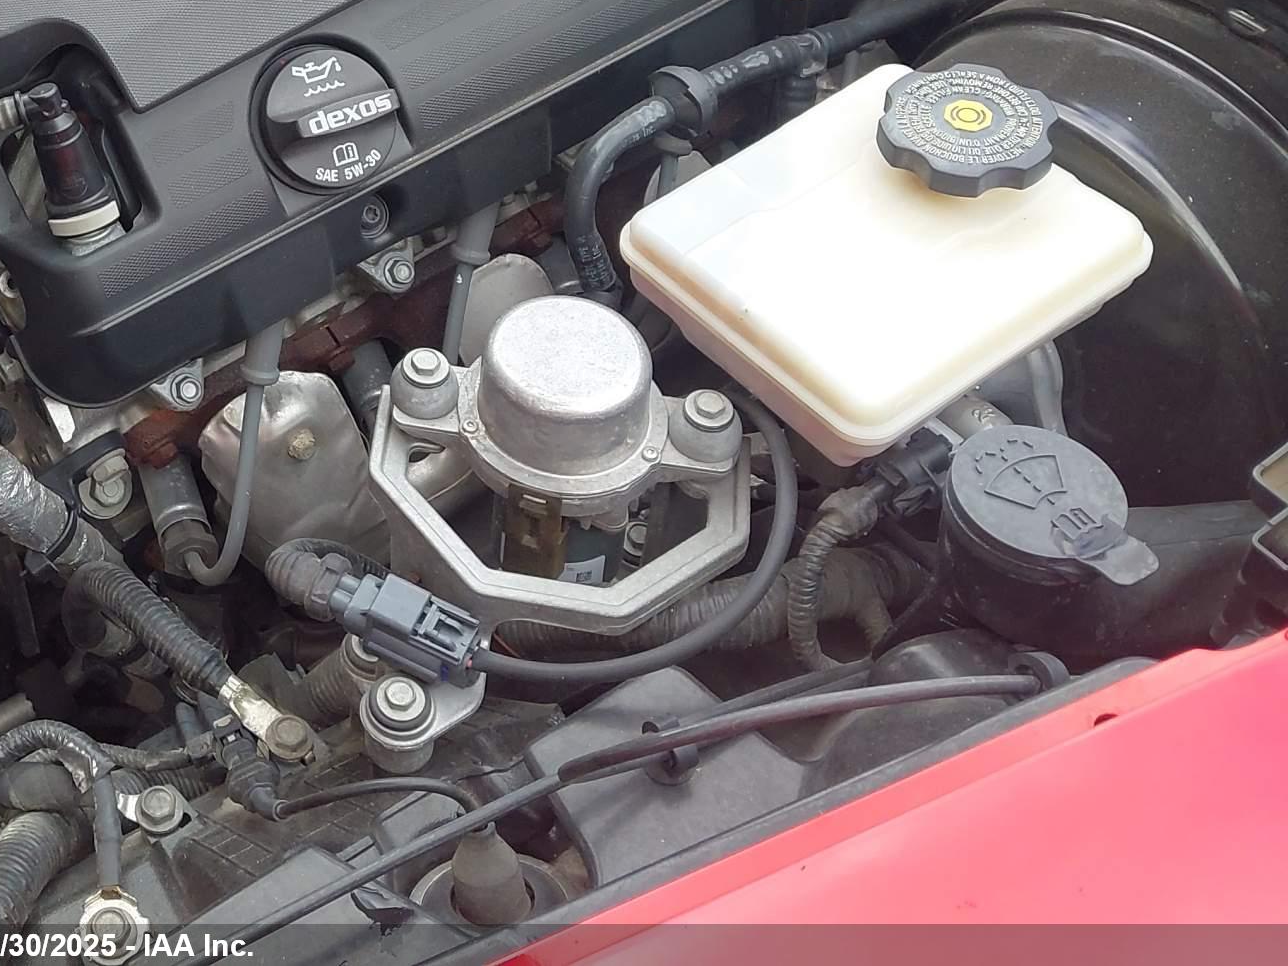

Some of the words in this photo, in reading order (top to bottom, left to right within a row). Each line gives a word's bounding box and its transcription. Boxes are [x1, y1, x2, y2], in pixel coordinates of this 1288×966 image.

[308, 93, 392, 134] dexos
[315, 167, 339, 182] SAE
[344, 149, 381, 180] 5W-30
[920, 144, 965, 162] BOUCHON
